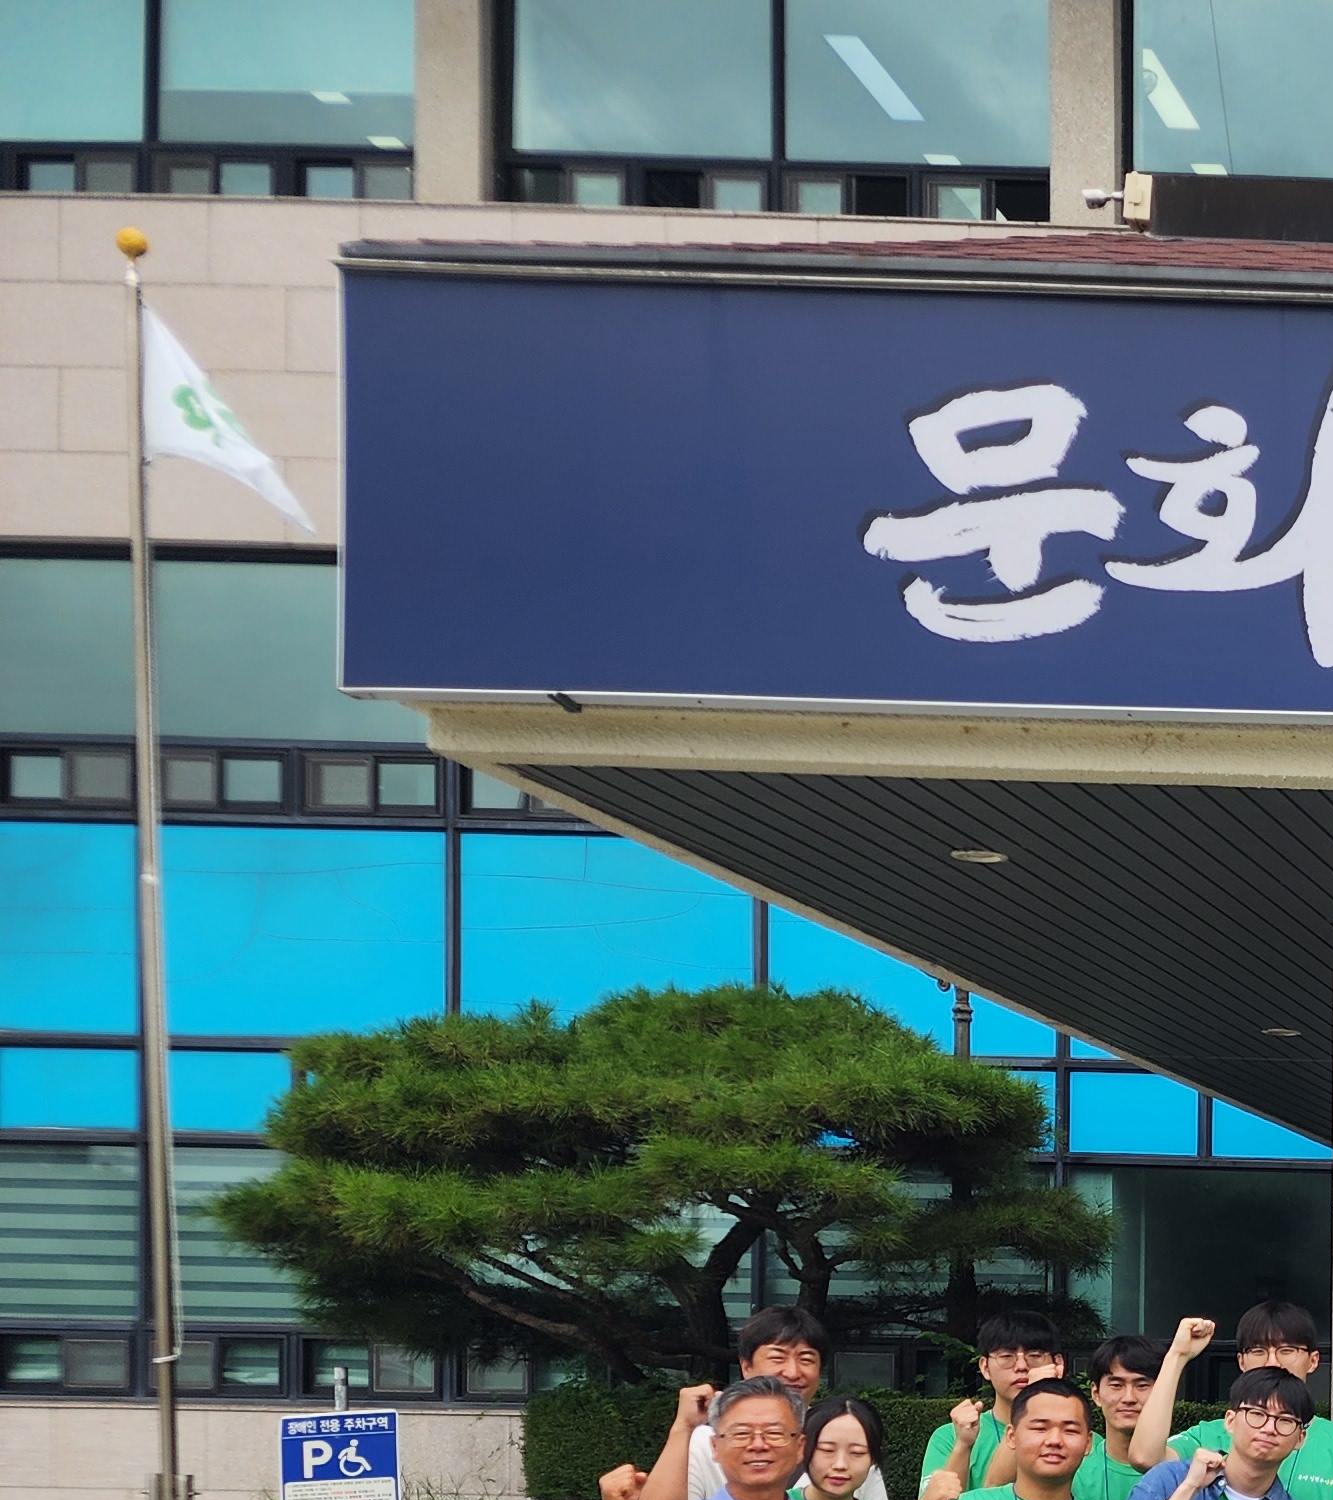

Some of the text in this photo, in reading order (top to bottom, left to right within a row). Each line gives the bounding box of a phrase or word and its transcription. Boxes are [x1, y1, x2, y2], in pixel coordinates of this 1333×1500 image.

[320, 1418, 341, 1433] 전용
[343, 1416, 389, 1431] 주차구역
[302, 1440, 333, 1479] P
